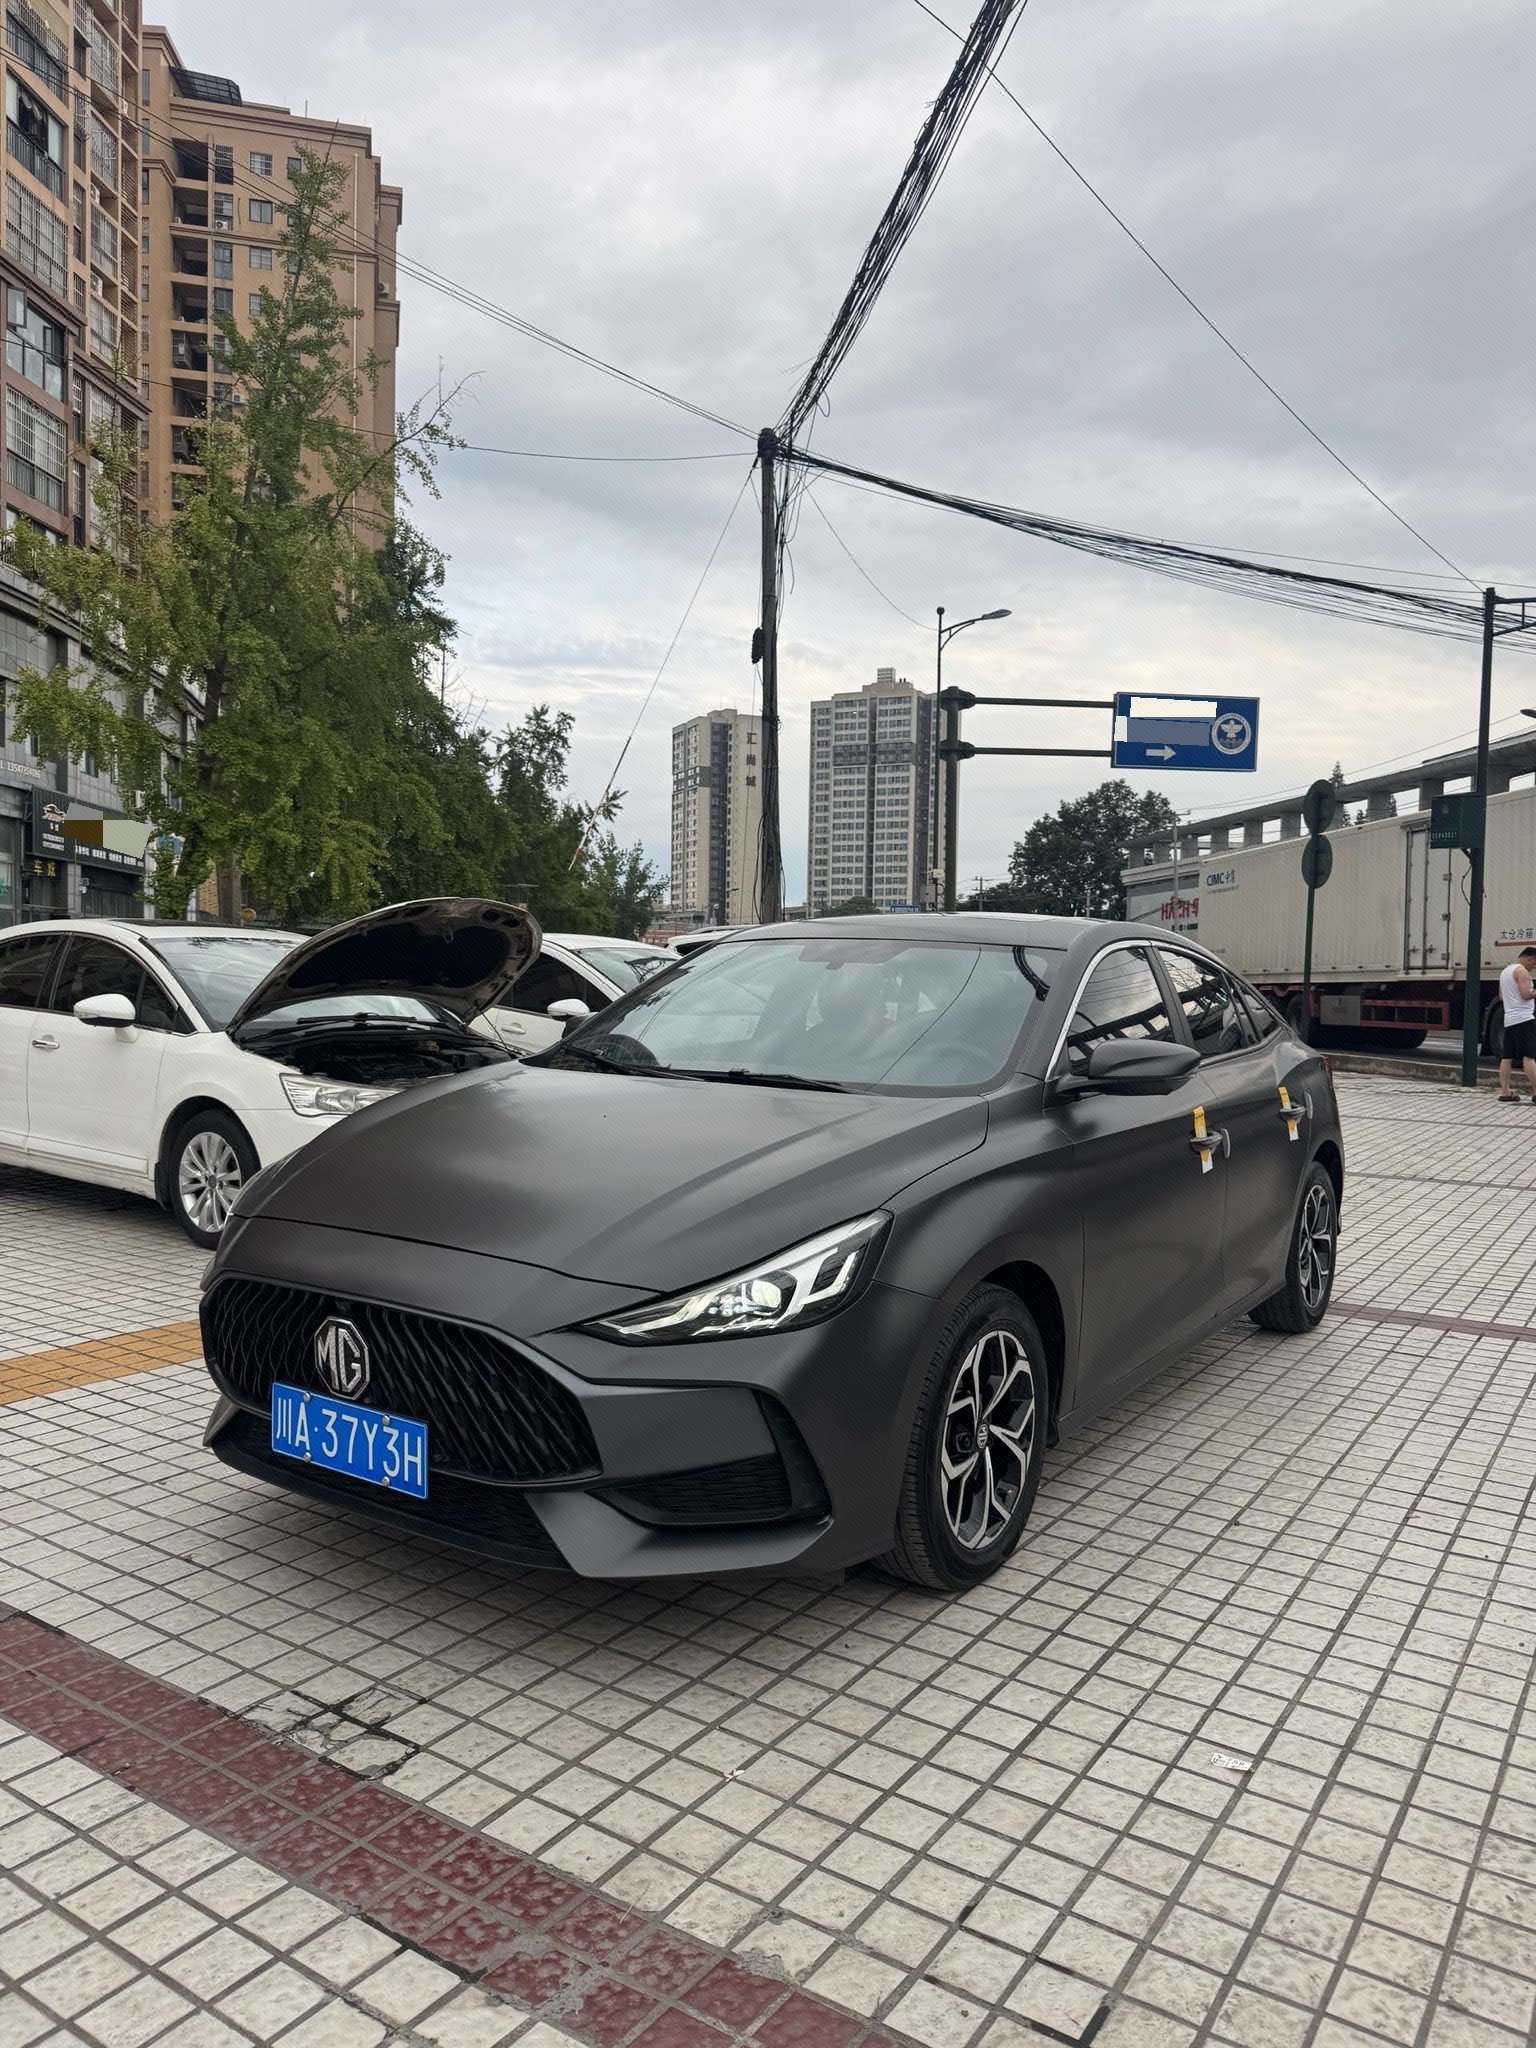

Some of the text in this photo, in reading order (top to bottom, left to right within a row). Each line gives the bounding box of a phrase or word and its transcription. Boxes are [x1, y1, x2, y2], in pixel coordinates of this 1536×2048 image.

[746, 732, 757, 788] 汇尚城
[1207, 872, 1225, 887] CIMC
[317, 1325, 362, 1393] MG
